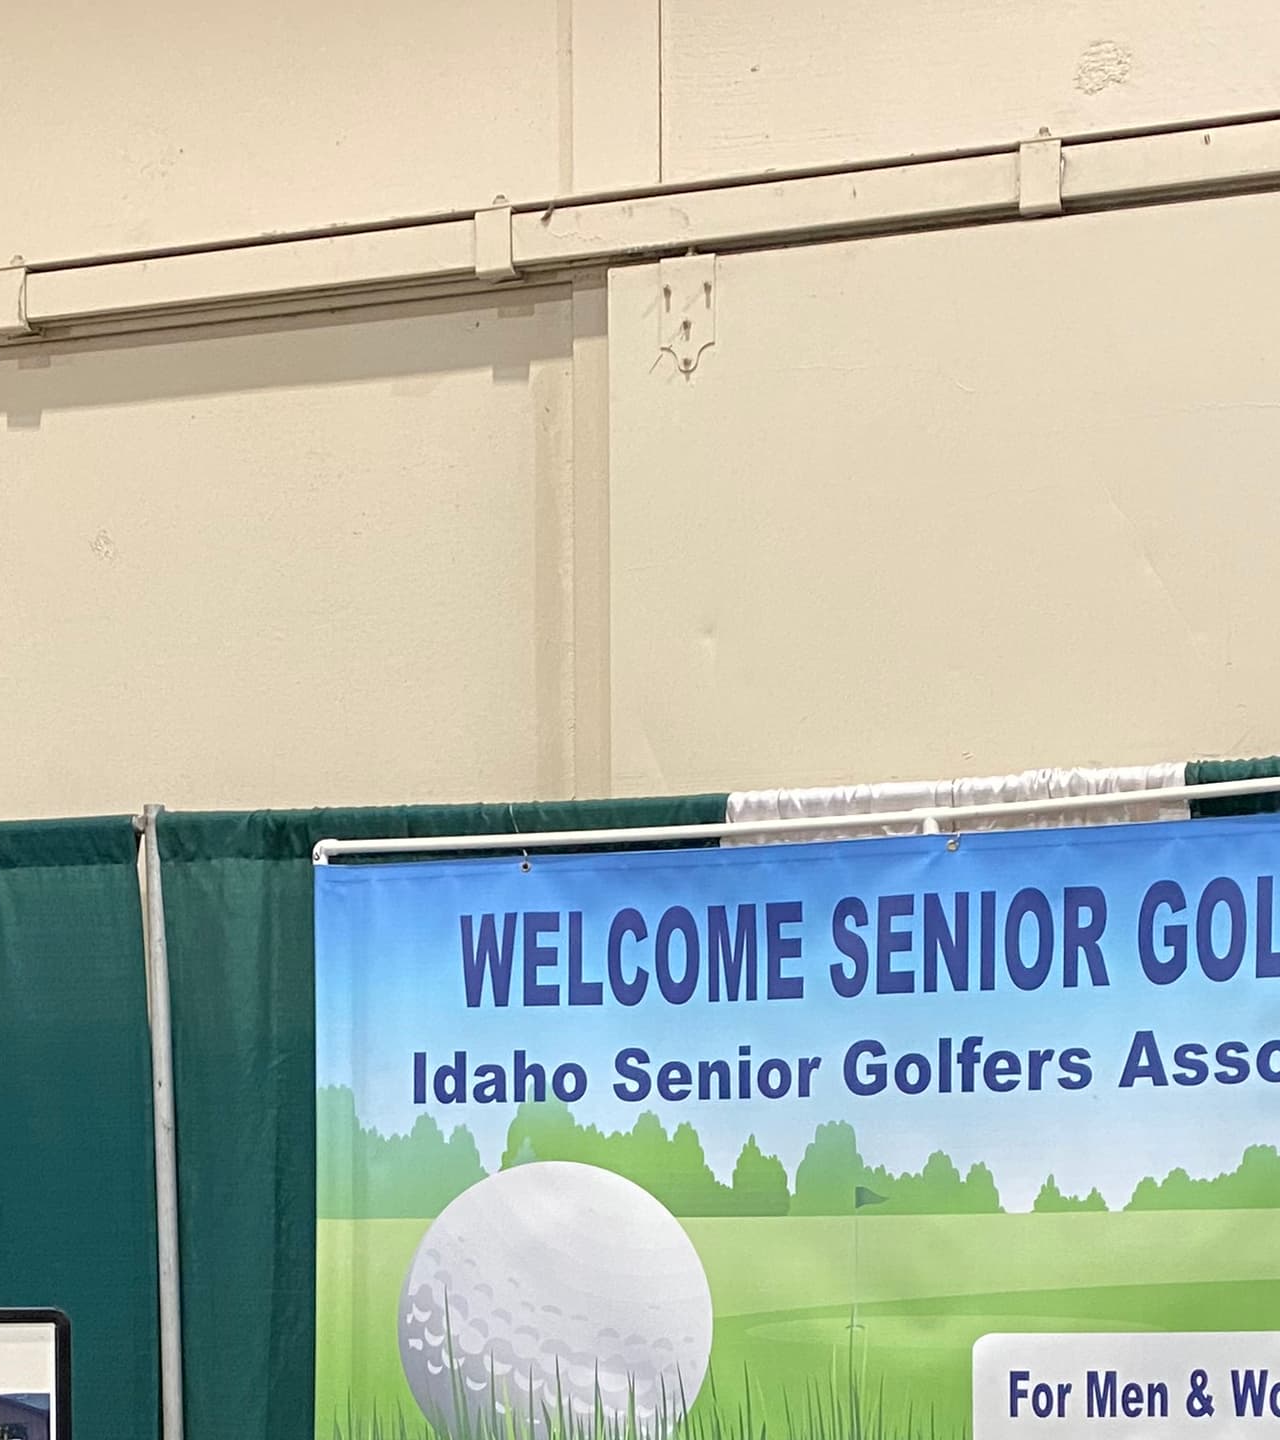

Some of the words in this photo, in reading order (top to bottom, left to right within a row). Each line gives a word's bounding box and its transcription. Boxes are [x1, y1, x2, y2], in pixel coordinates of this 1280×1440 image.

[460, 901, 805, 1007] WELCOME
[830, 886, 1110, 998] SENIOR
[413, 1050, 587, 1104] Idaho
[613, 1045, 821, 1102] Senior
[843, 1036, 1092, 1096] Golfers
[1009, 1370, 1072, 1419] For
[1086, 1369, 1169, 1418] Men
[1186, 1368, 1215, 1418] &
